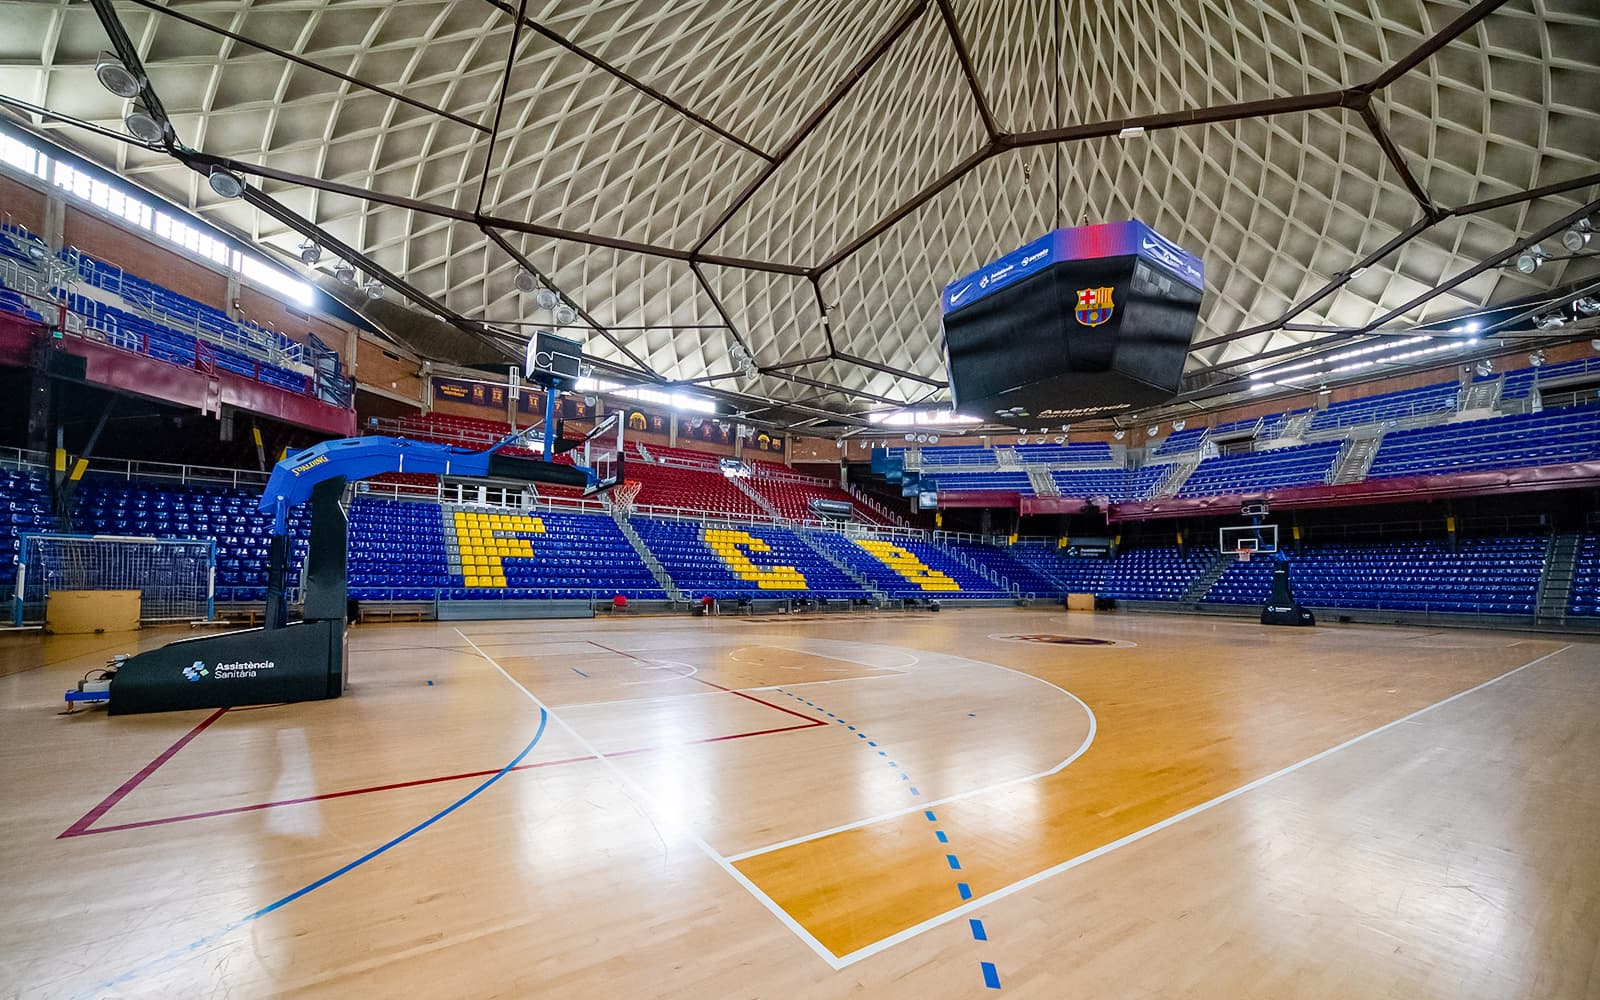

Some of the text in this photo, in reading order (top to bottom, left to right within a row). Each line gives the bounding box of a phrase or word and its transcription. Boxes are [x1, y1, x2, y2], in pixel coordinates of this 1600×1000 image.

[291, 455, 329, 477] SPALDING
[454, 512, 546, 587] F
[214, 660, 275, 671] Assistència
[214, 669, 257, 679] Sanitària
